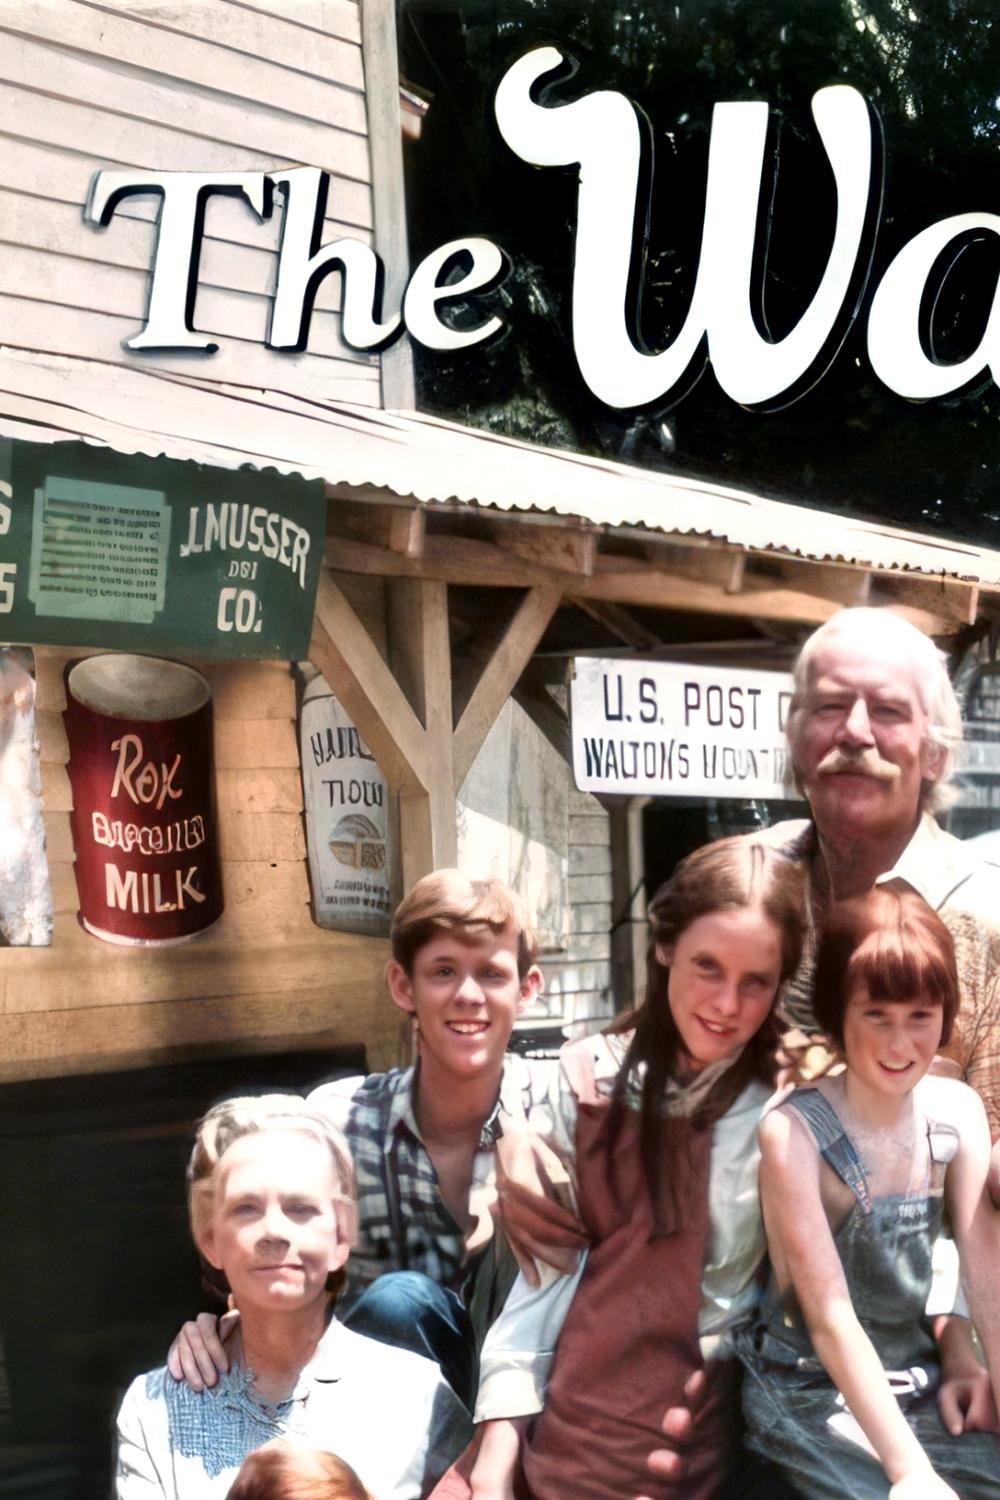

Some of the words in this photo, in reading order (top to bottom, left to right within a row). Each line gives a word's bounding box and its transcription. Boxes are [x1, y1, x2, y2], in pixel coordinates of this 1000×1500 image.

[603, 674, 664, 726] U.S.
[684, 682, 762, 731] POST
[111, 734, 183, 811] Rox
[105, 863, 206, 913] MILK
